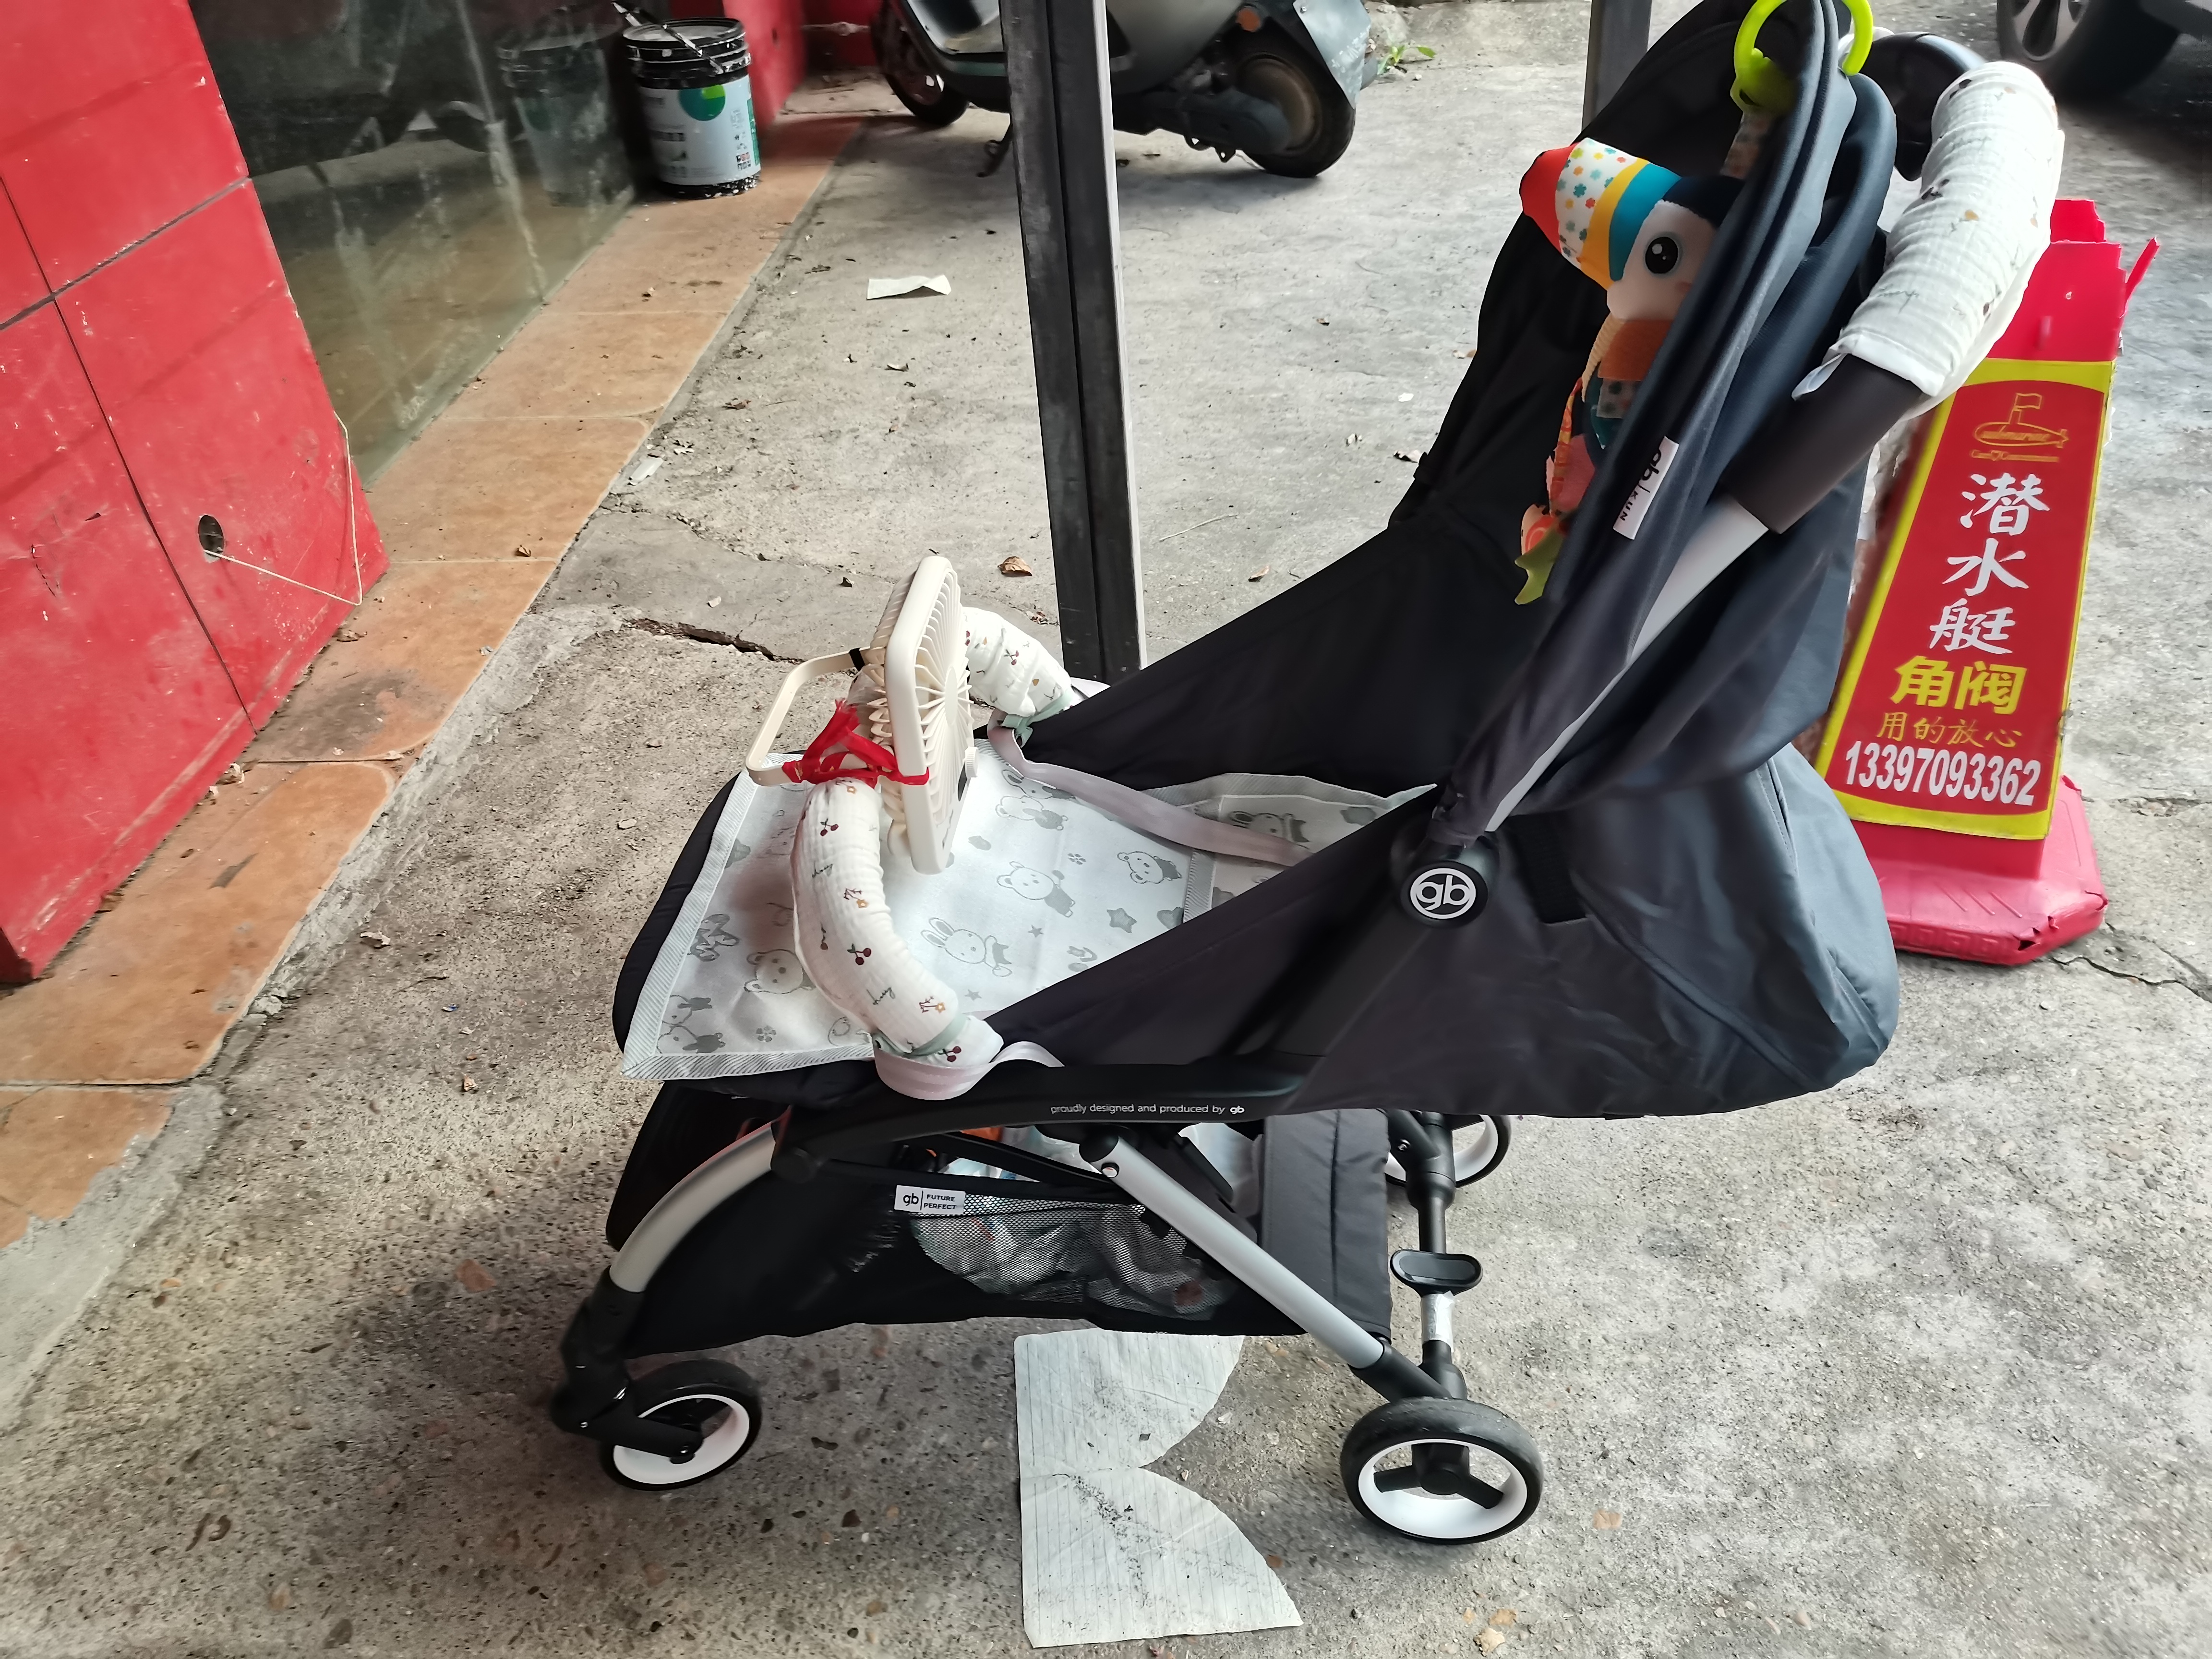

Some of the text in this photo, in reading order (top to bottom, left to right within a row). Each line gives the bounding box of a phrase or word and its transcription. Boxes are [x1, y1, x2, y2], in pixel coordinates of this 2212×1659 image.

[1929, 473, 2050, 654] 潜水艇
[1890, 655, 2027, 714] 角阀
[1876, 711, 2025, 748] 用的放心
[1845, 740, 2041, 806] 13397093362
[1415, 875, 1471, 911] gb
[1050, 1104, 1245, 1115] proudly designed and produced by gb
[903, 1192, 919, 1206] gb
